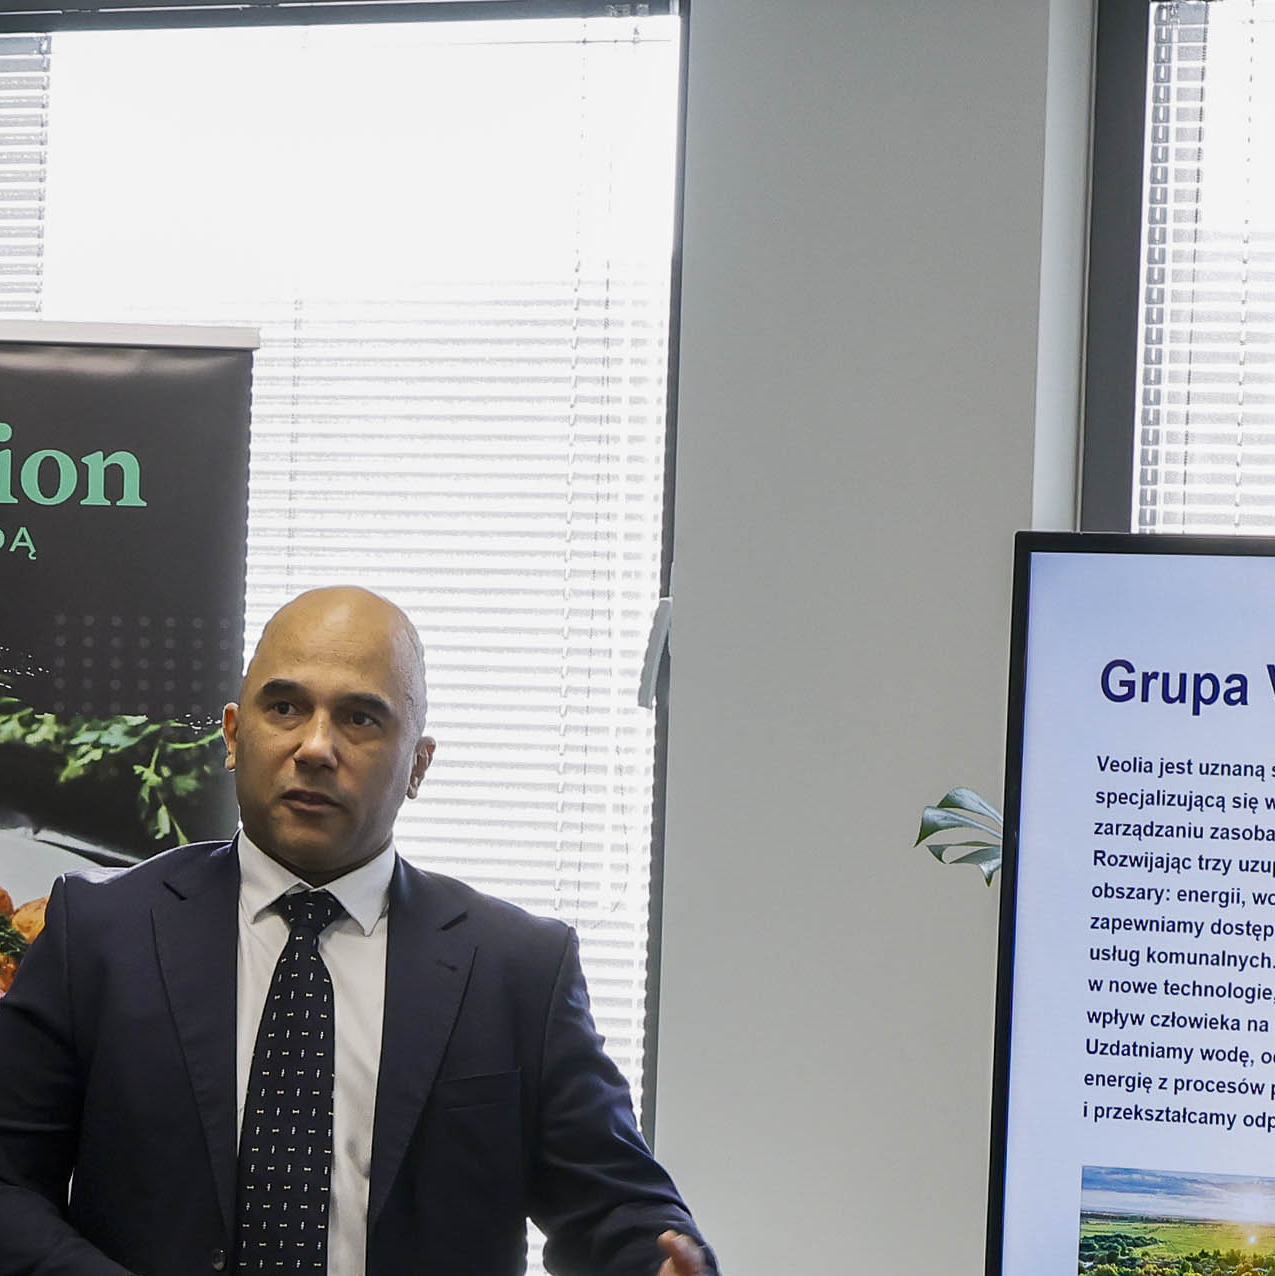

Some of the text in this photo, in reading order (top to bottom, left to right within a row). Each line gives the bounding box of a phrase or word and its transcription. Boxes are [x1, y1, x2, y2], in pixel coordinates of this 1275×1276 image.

[1100, 658, 1249, 717] Grupa
[1096, 755, 1154, 774] Veolia
[1157, 757, 1193, 779] jest
[1198, 762, 1266, 782] uznaną
[1095, 788, 1226, 813] specjalizującą
[1232, 792, 1259, 815] się
[1093, 820, 1204, 842] zarządzaniu
[1093, 849, 1192, 875] Rozwijając
[1197, 854, 1233, 876] trzy
[1091, 881, 1170, 906] obszary:
[1176, 887, 1246, 909] energii,
[1090, 915, 1205, 939] zapewniamy
[1210, 918, 1275, 942] dostęp
[1089, 945, 1141, 968] usług
[1087, 978, 1104, 992] w
[1108, 979, 1158, 995] nowe
[1086, 1008, 1146, 1030] wpływ
[1150, 1011, 1241, 1032] człowieka
[1247, 1019, 1269, 1033] na
[1085, 1038, 1194, 1065] Uzdatniamy
[1199, 1046, 1255, 1068] wodę,
[1083, 1071, 1153, 1094] energię
[1157, 1077, 1168, 1091] z
[1173, 1077, 1266, 1096] procesów
[1083, 1100, 1088, 1118] i
[1092, 1104, 1237, 1132] przekształcamy
